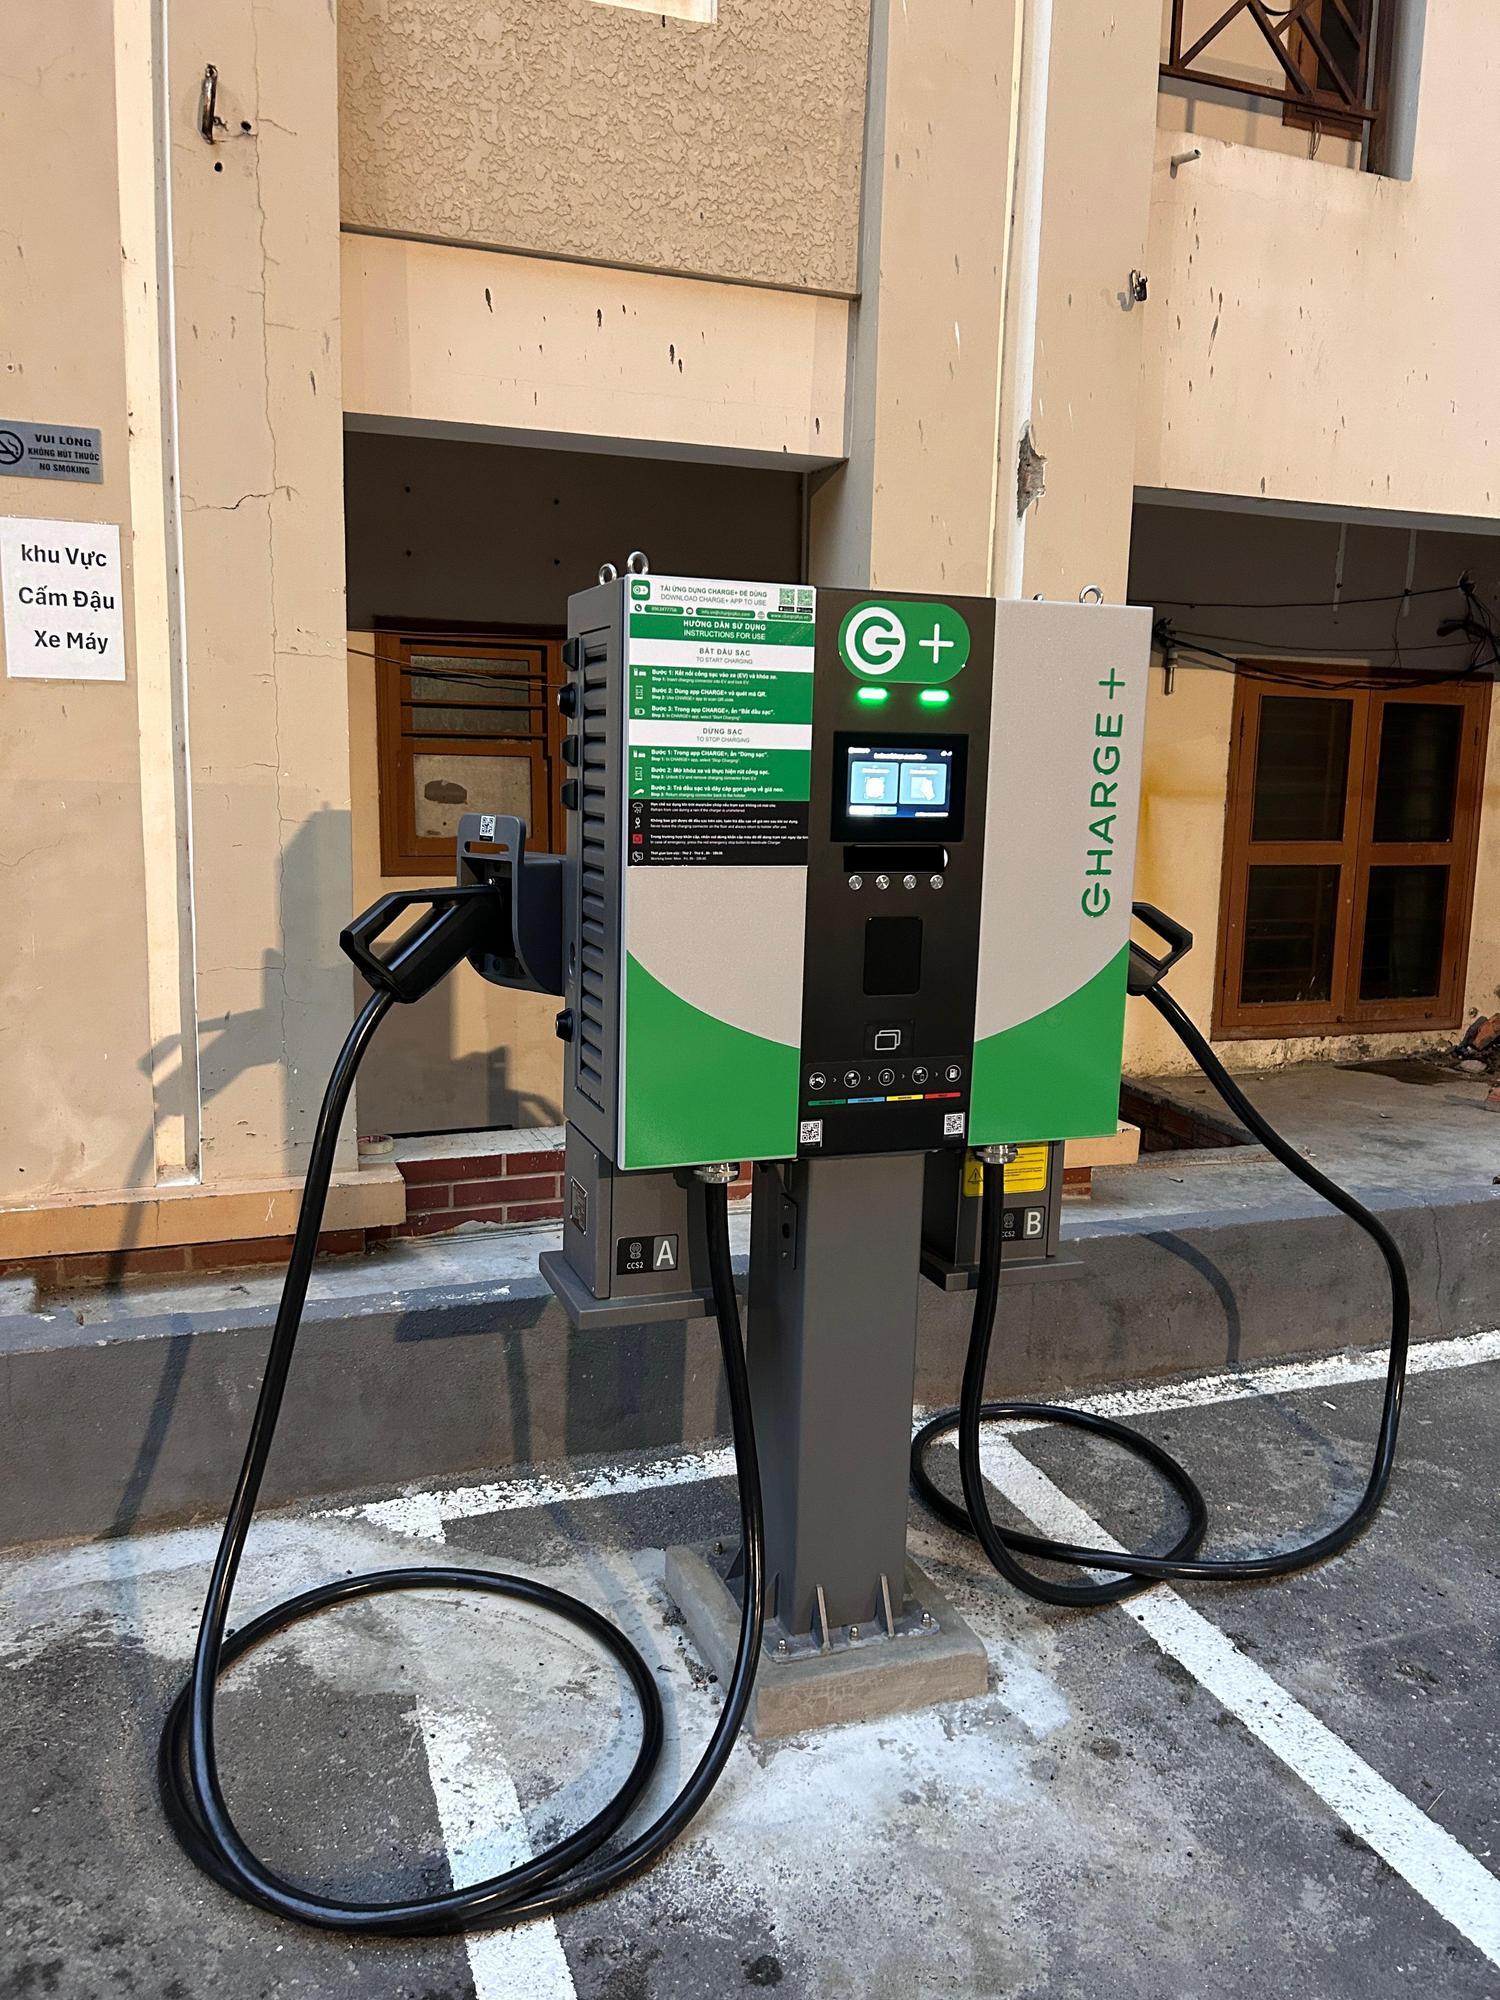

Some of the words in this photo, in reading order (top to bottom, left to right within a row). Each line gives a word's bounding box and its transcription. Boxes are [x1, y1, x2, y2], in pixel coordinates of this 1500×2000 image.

[35, 434, 55, 443] VUI
[53, 464, 90, 474] SMOKING
[22, 544, 60, 563] khu
[65, 548, 107, 570] Vực
[19, 586, 67, 606] Cấm
[73, 591, 114, 612] Đậu
[34, 630, 60, 648] Xe
[67, 632, 108, 654] Máy
[684, 630, 734, 638] INSTRUCTIONS
[1026, 1212, 1041, 1235] B
[656, 1240, 674, 1267] A
